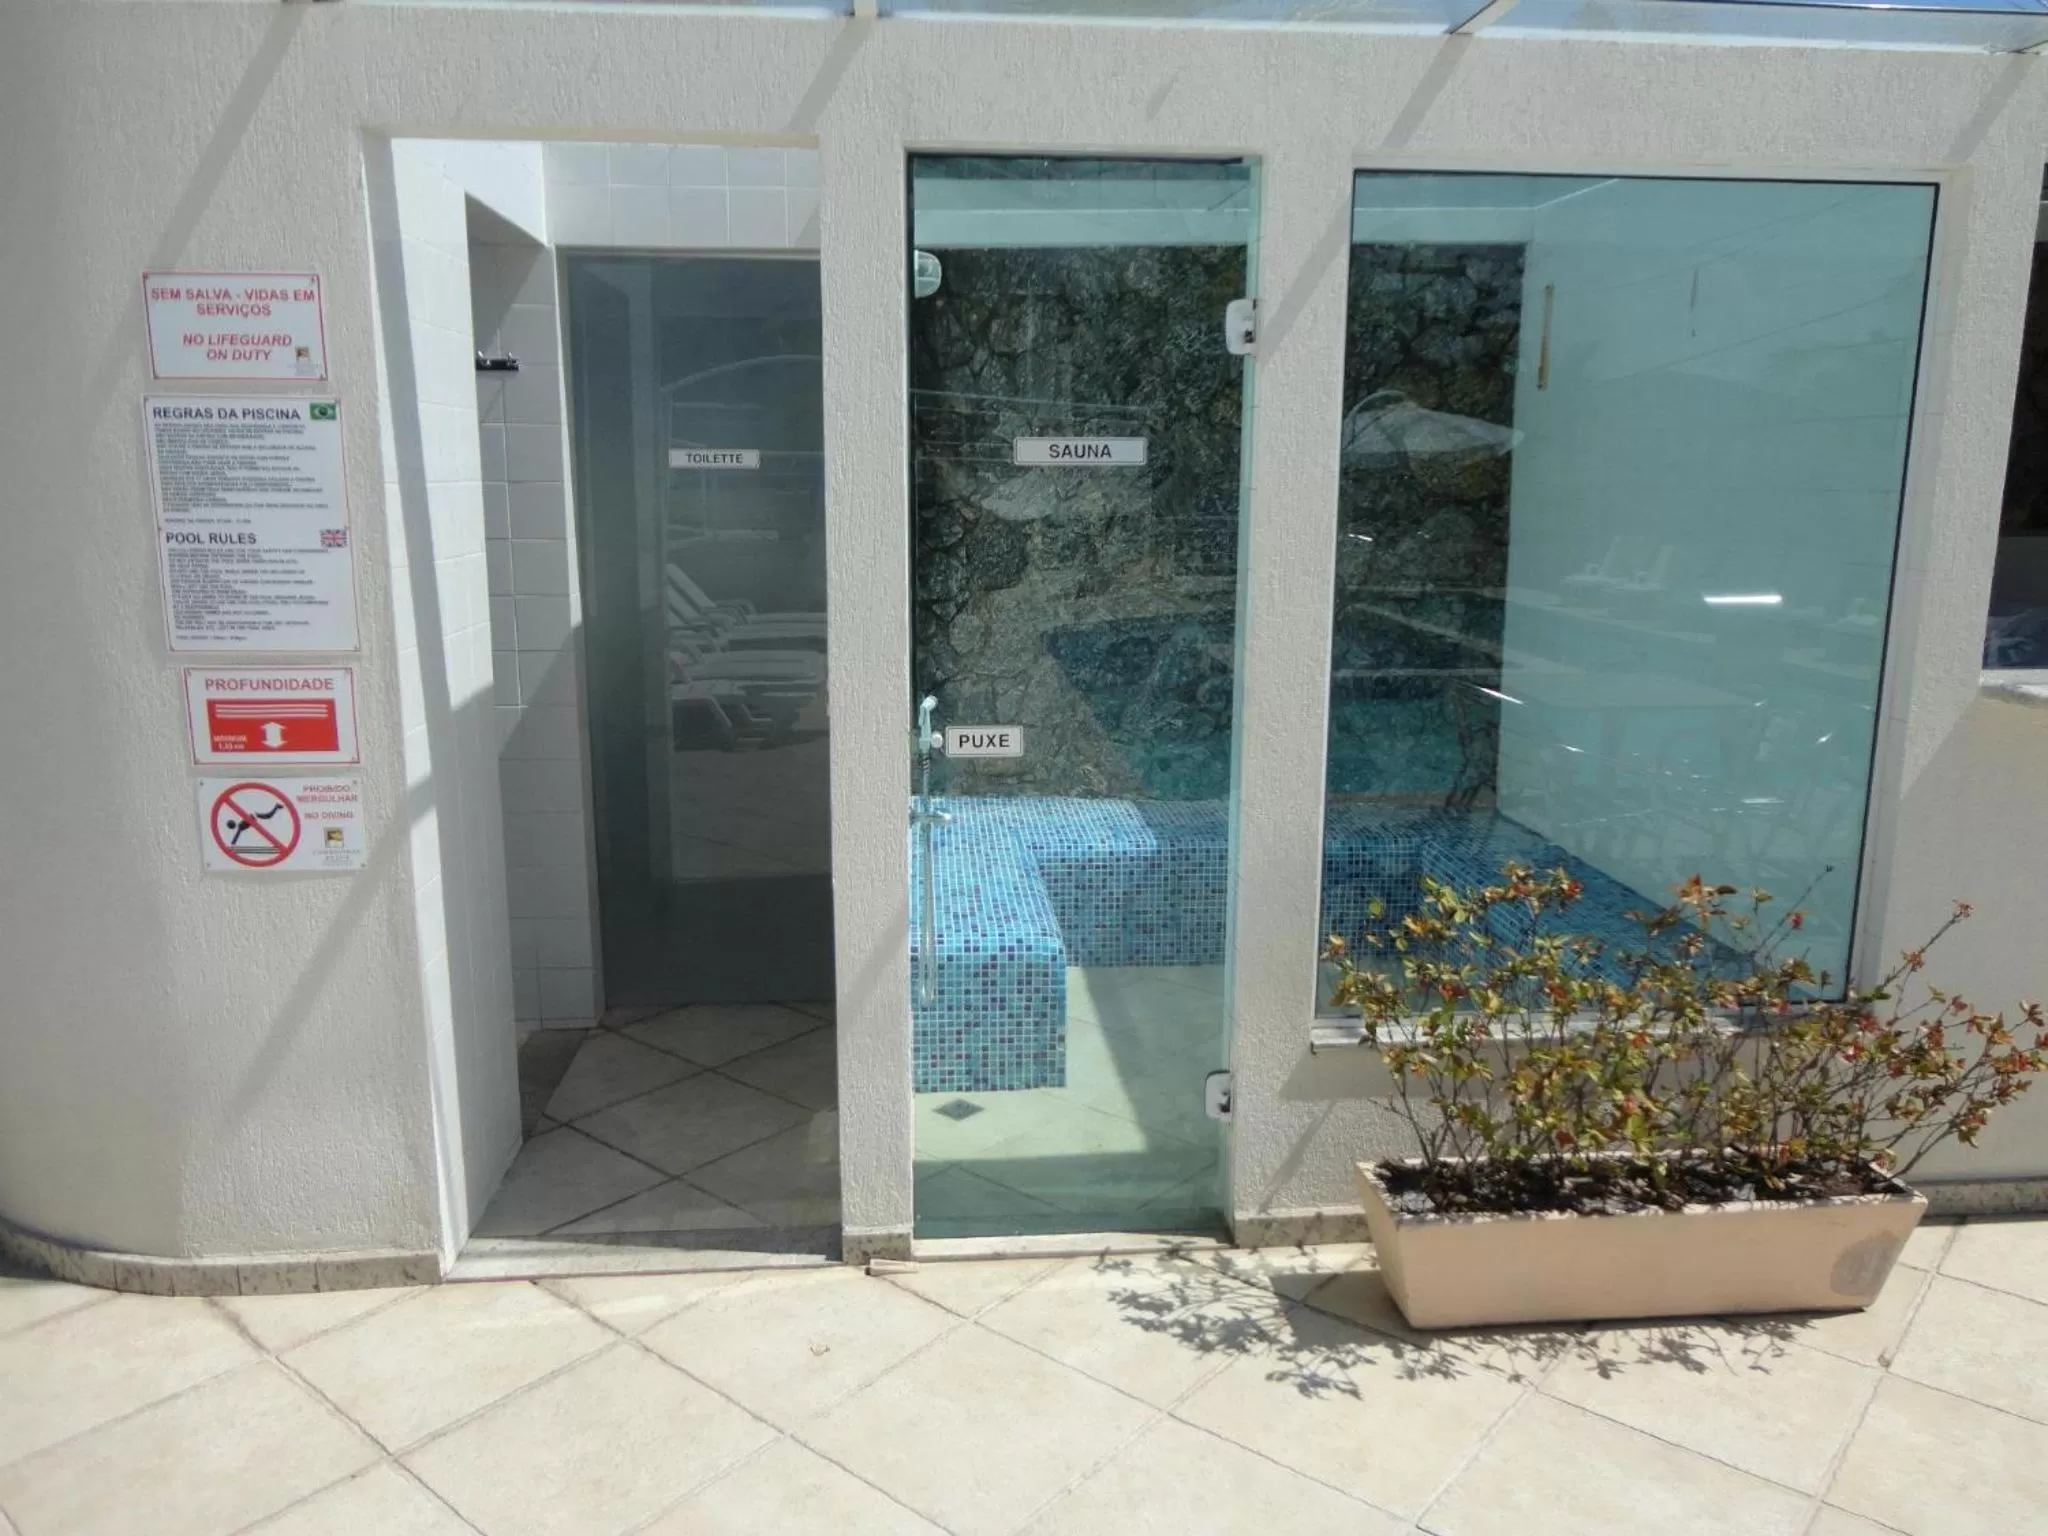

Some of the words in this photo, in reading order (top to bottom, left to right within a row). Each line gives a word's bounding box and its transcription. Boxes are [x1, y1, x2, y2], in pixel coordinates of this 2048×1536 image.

[151, 288, 181, 300] SEM
[186, 288, 232, 301] SALVA
[244, 288, 289, 301] VIDAS
[294, 290, 315, 302] EM
[197, 303, 272, 318] SERVIÇOS
[183, 333, 204, 346] NO
[208, 333, 293, 346] LIFEGUARD
[207, 350, 228, 361] ON
[232, 350, 272, 361] DUTY
[152, 406, 214, 420] REGRAS
[218, 407, 239, 420] DA
[242, 407, 301, 421] PISCINA
[1049, 443, 1112, 459] SAUNA
[685, 453, 743, 464] TOILETTE
[165, 531, 206, 545] POOL
[209, 532, 258, 545] RULES
[205, 677, 335, 691] PROFUNDIDADE
[958, 734, 1011, 749] PUXE
